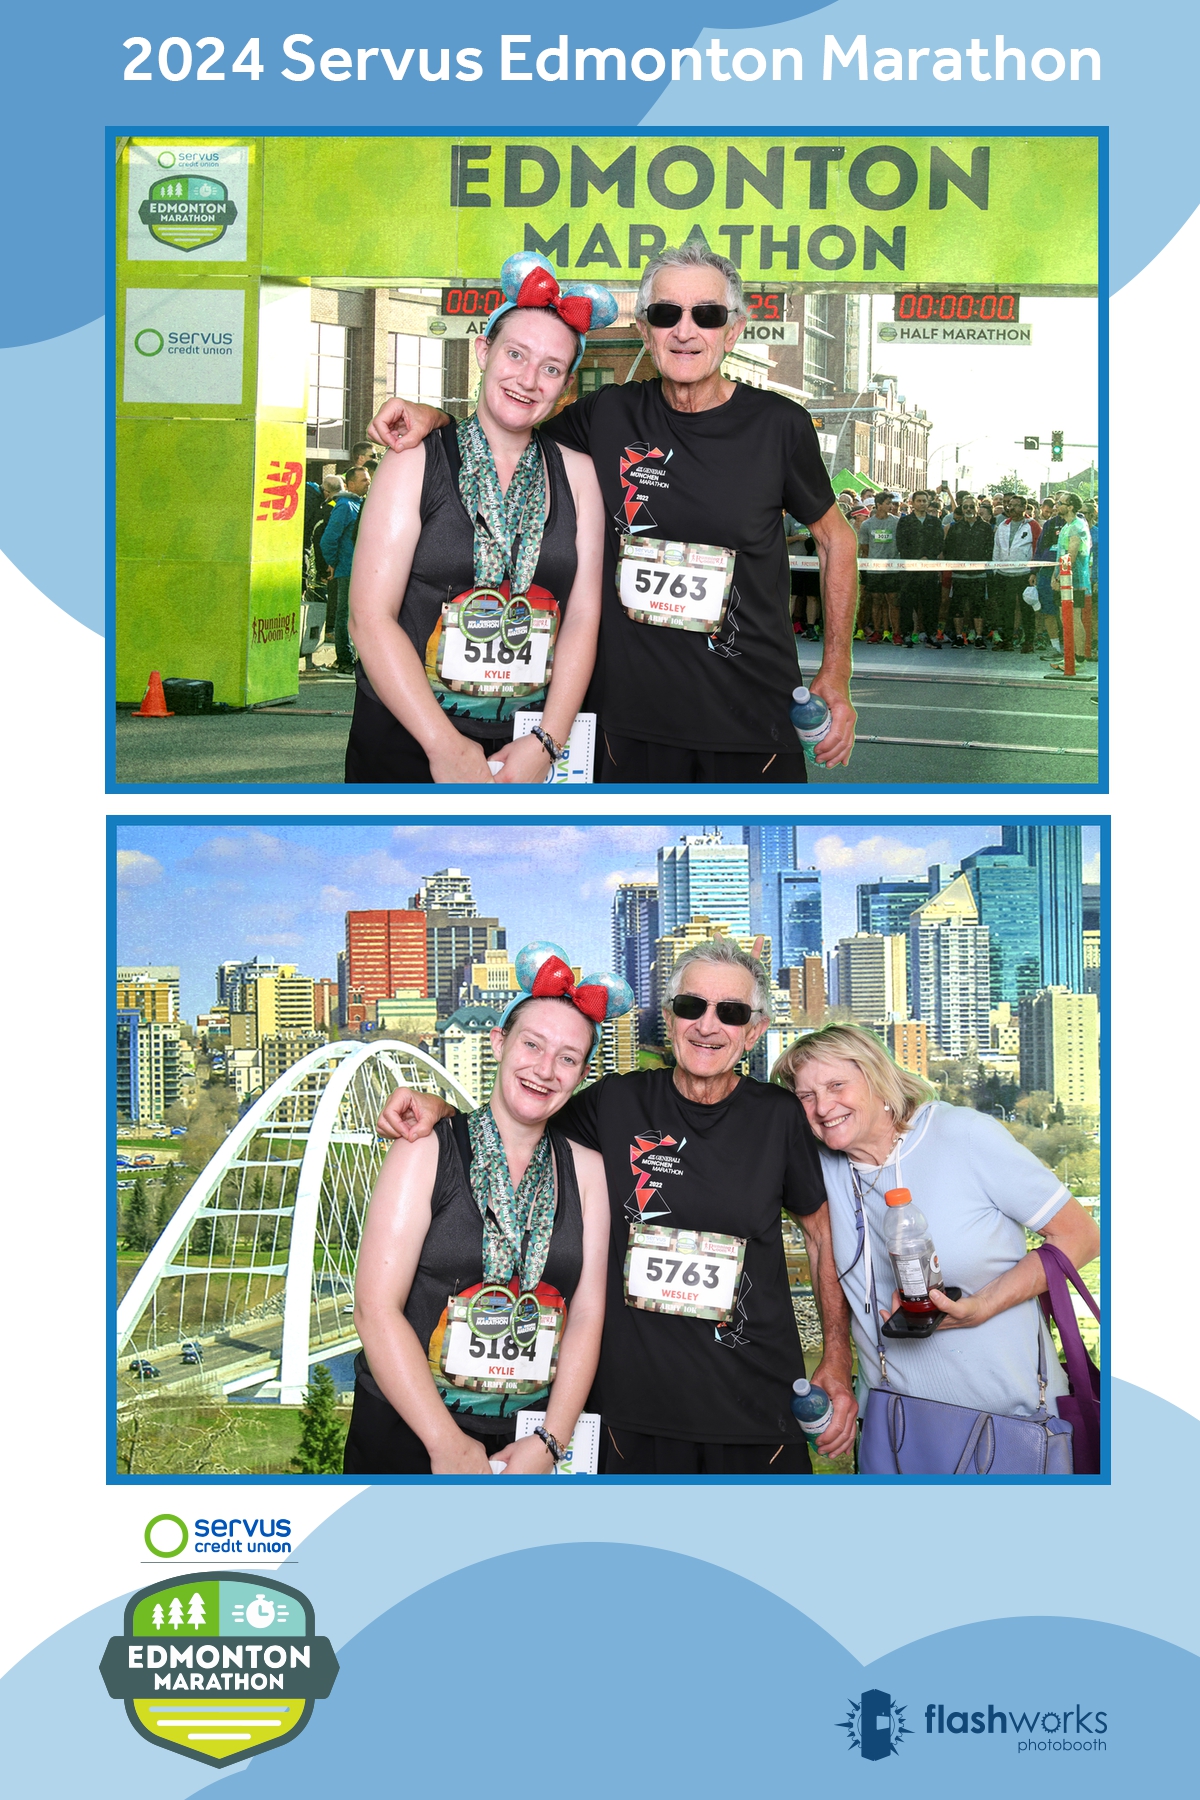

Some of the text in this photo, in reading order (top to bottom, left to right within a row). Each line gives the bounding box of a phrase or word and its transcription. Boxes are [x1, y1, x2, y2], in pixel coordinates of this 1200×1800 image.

[178, 152, 219, 161] servus
[450, 144, 990, 211] EDMONTON
[149, 203, 226, 214] EDMONTON
[160, 214, 215, 222] MARATHON
[168, 331, 233, 345] servus
[743, 326, 785, 340] HON
[900, 328, 939, 340] HALF
[942, 328, 1031, 341] MARATHON
[167, 345, 233, 355] credit union
[639, 479, 670, 489] MARATHON
[636, 494, 649, 502] 2022
[635, 568, 708, 601] 5763
[649, 600, 686, 613] WESLEY
[647, 614, 684, 626] ARMY 10K
[464, 637, 532, 665] 5184
[484, 670, 511, 679] KYLIE
[478, 684, 500, 692] ARMY
[652, 1166, 684, 1176] MARATHON
[649, 1180, 663, 1188] 2022
[646, 1256, 720, 1289] 5763
[661, 1289, 699, 1301] WESLEY
[660, 1303, 681, 1312] ARMY
[468, 1333, 536, 1361] 5184
[488, 1366, 515, 1375] KYLIE
